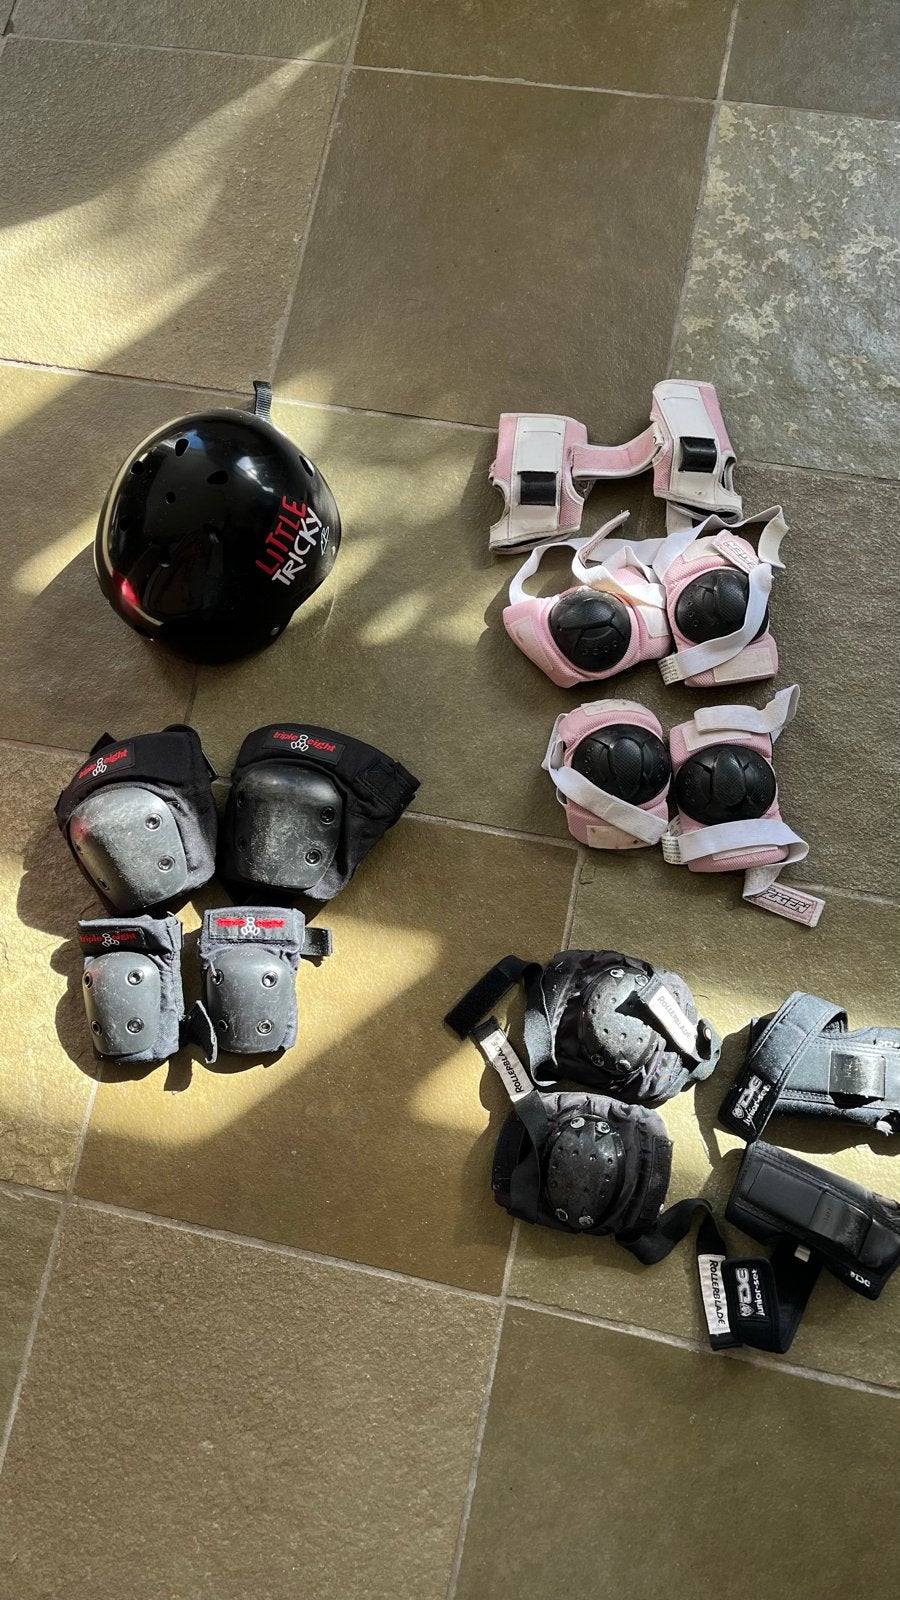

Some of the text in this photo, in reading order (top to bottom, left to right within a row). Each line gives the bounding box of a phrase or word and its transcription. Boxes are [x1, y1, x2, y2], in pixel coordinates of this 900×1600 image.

[255, 495, 307, 575] LITTLE
[271, 507, 323, 585] TRICKY
[103, 749, 128, 764] eight
[272, 730, 337, 752] triple eight
[658, 994, 692, 1039] ROLLERBLADE
[490, 1039, 525, 1094] ROLLERBLADE
[709, 1259, 726, 1326] ROLLERBLADE
